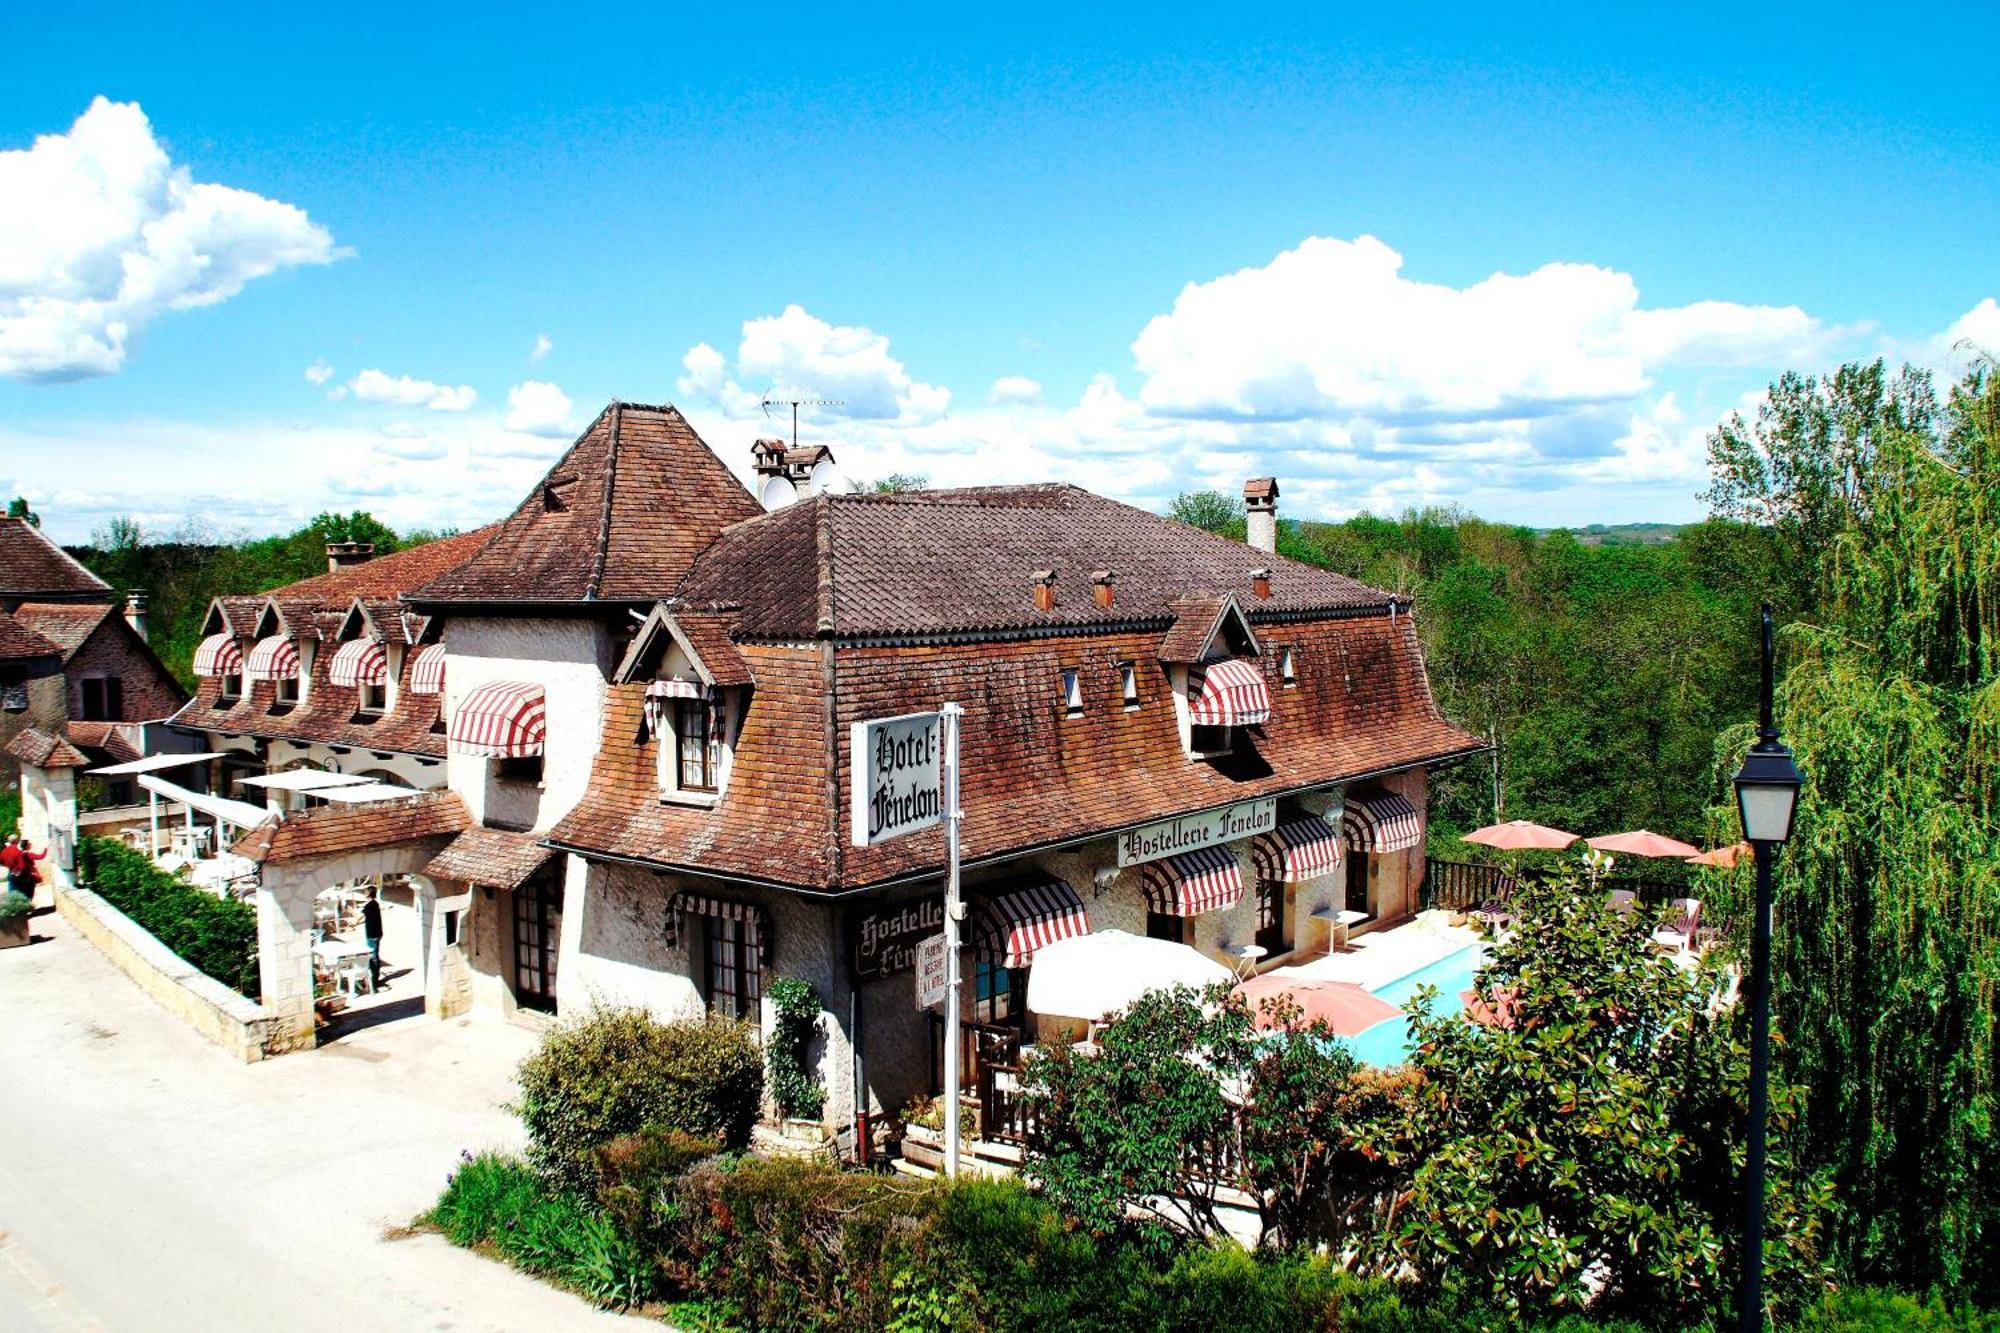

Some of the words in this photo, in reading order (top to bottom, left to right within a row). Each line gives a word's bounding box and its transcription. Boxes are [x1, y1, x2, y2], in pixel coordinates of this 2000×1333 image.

[869, 782, 939, 837] Fénelon
[1120, 820, 1209, 864] Hostellerie
[1218, 804, 1270, 837] Fénelon
[861, 901, 944, 957] Hostelle
